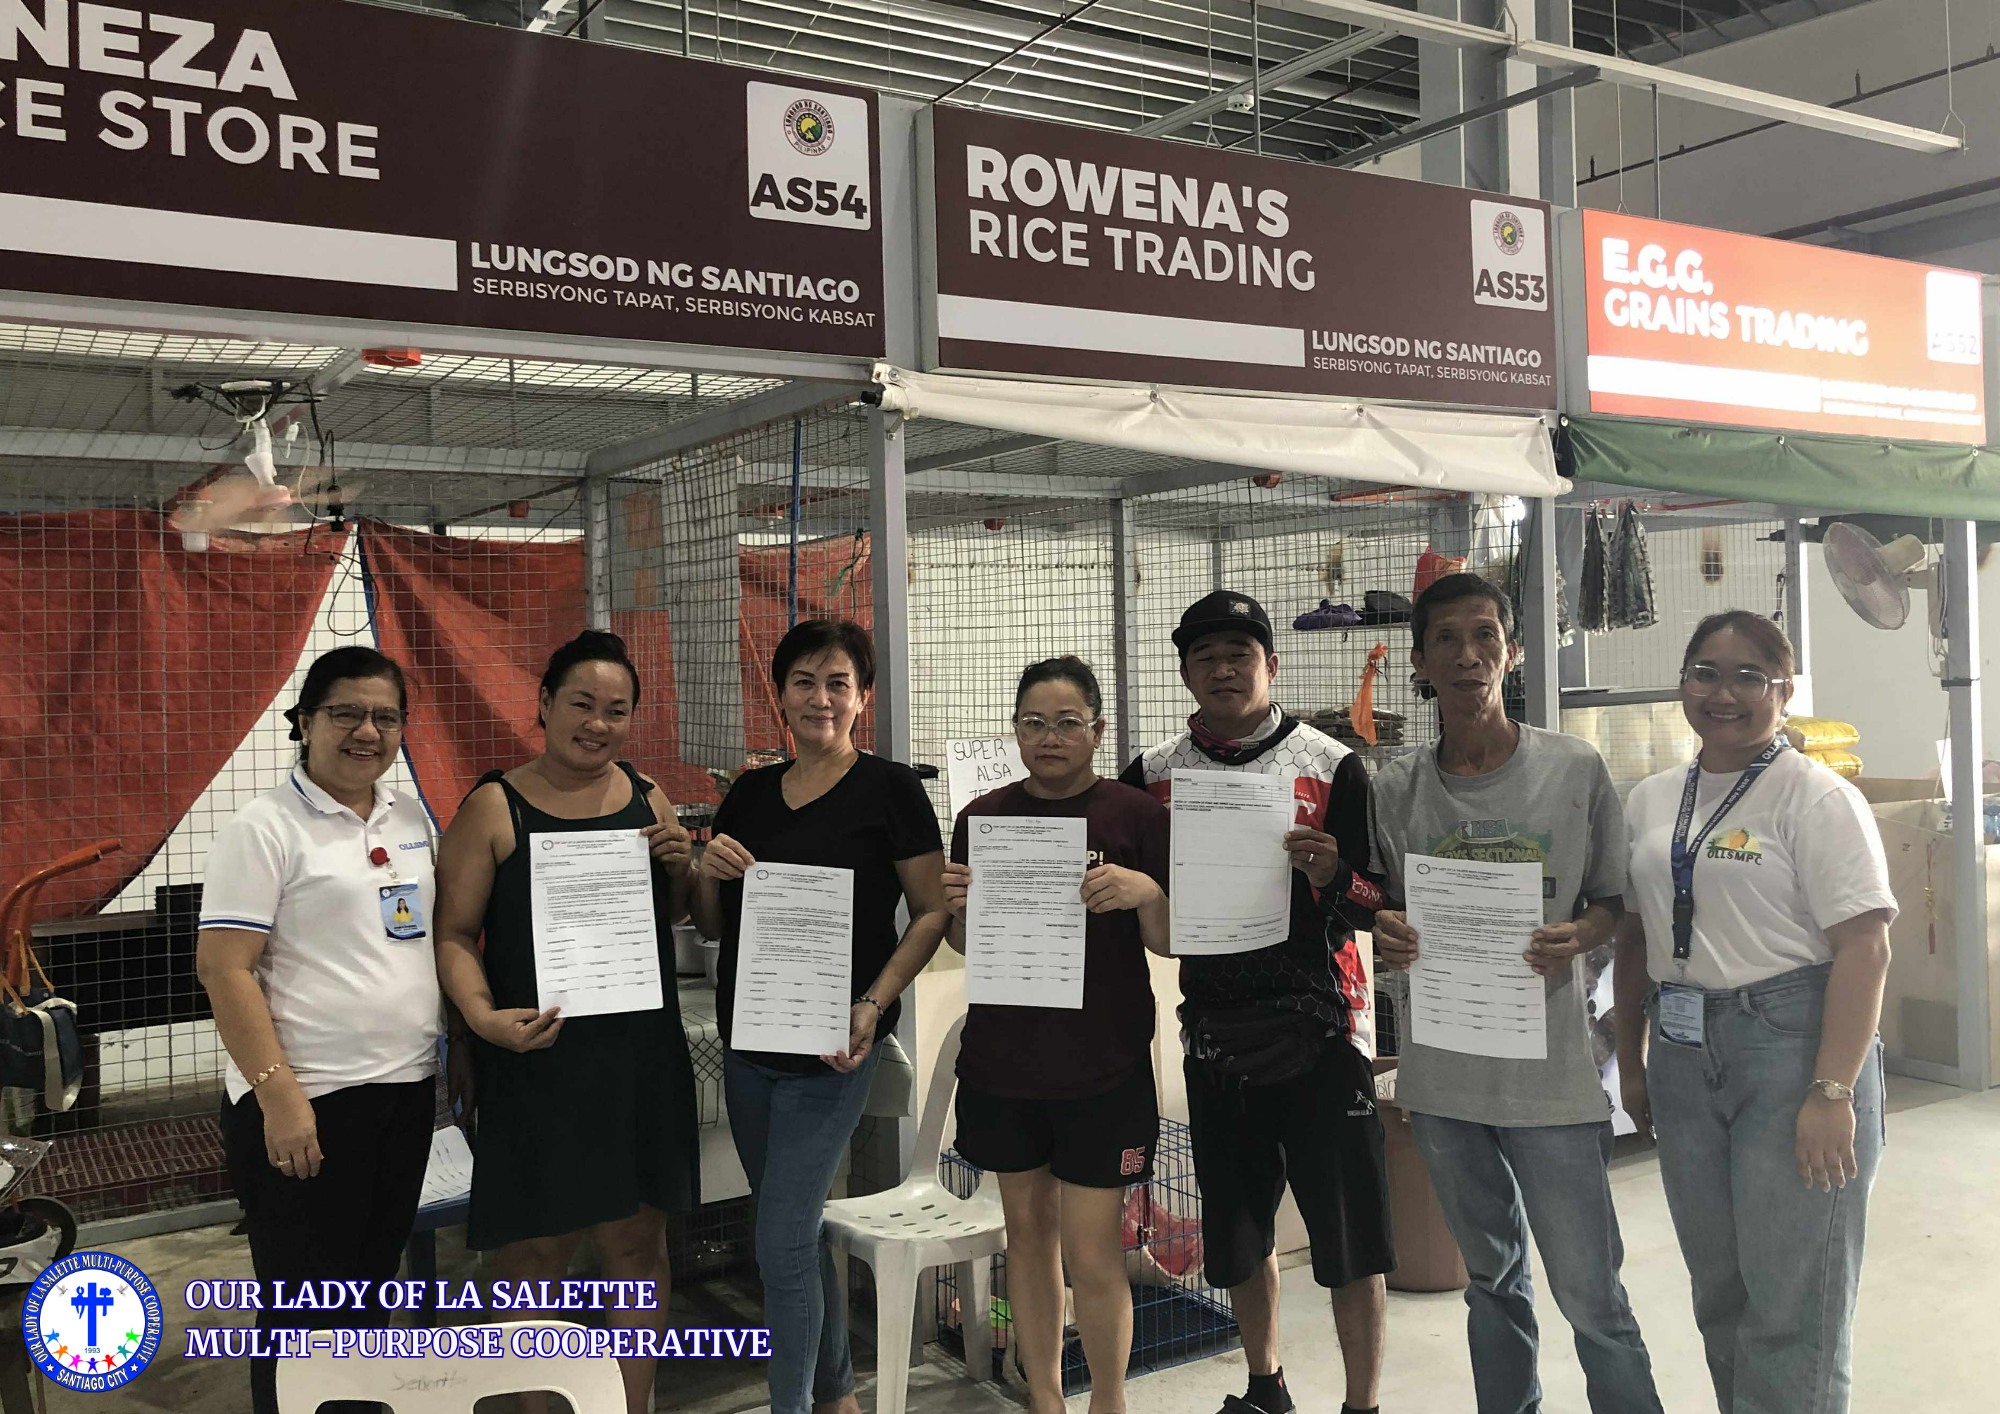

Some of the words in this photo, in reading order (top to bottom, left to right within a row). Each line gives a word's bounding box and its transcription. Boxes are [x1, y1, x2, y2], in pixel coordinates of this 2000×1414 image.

[0, 0, 298, 101] NEZA
[0, 78, 66, 141] E
[98, 90, 380, 180] STORE
[750, 173, 867, 220] AS54
[967, 144, 1290, 238] ROWENA'S
[471, 241, 640, 282] LUNGSOD
[647, 259, 694, 288] NG
[701, 265, 860, 303] SANTIAGO
[969, 209, 1090, 267] RICE
[1104, 226, 1316, 291] TRADING
[1602, 237, 1713, 295] E.G.G.
[473, 277, 608, 304] SERBISYONG
[613, 290, 679, 313] TAPAT,
[685, 297, 803, 322] SERBISYONG
[809, 308, 876, 328] KABSAT
[1475, 268, 1545, 303] AS53
[1604, 288, 1730, 339] GRAINS
[1735, 305, 1869, 356] TRADING
[1312, 329, 1410, 357] LUNGSOD
[1414, 339, 1442, 360] NG
[1446, 342, 1542, 368] SANTIAGO
[1313, 356, 1392, 375] SERBISYONG
[1395, 363, 1434, 379] TAPAT,
[1437, 366, 1508, 383] SERBISYONG
[1511, 372, 1551, 386] KABSAT
[954, 739, 1006, 761] SUPER
[977, 763, 1012, 781] ALSA
[1471, 847, 1541, 862] SECTIONAL
[1707, 850, 1763, 865] OLLSMPC
[1120, 1145, 1146, 1175] 85
